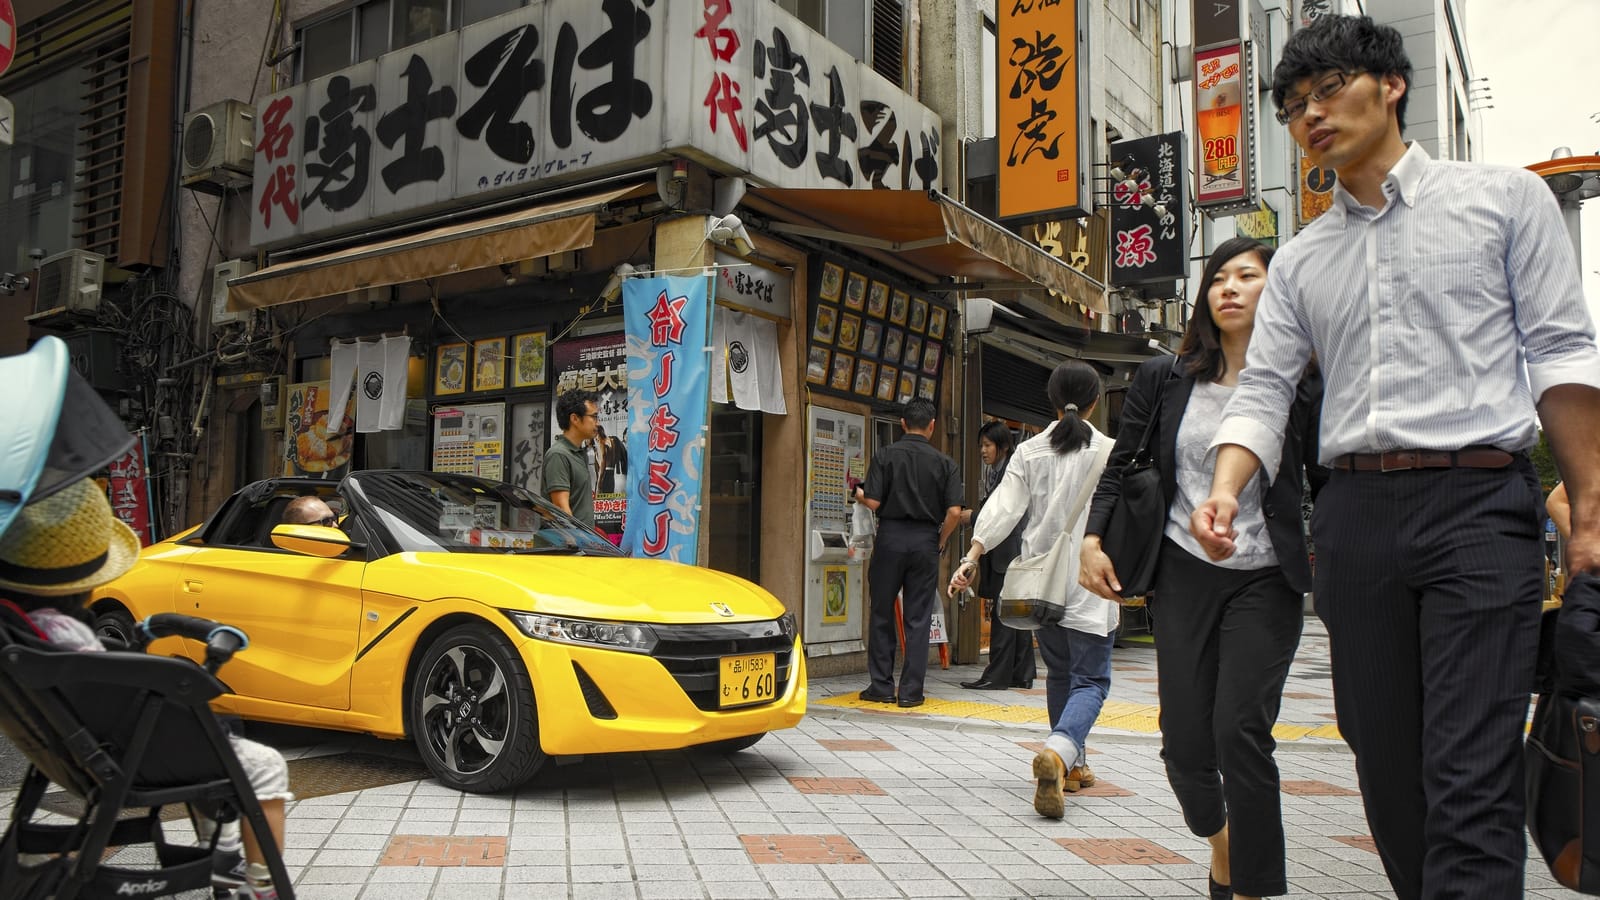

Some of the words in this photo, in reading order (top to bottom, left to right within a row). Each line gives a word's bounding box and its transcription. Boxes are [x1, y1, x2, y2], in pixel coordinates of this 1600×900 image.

[301, 0, 655, 212] 富士そば
[694, 0, 748, 153] 名代
[256, 95, 299, 229] 名代
[1158, 141, 1176, 241] 北海道らめん
[1204, 136, 1237, 161] 280
